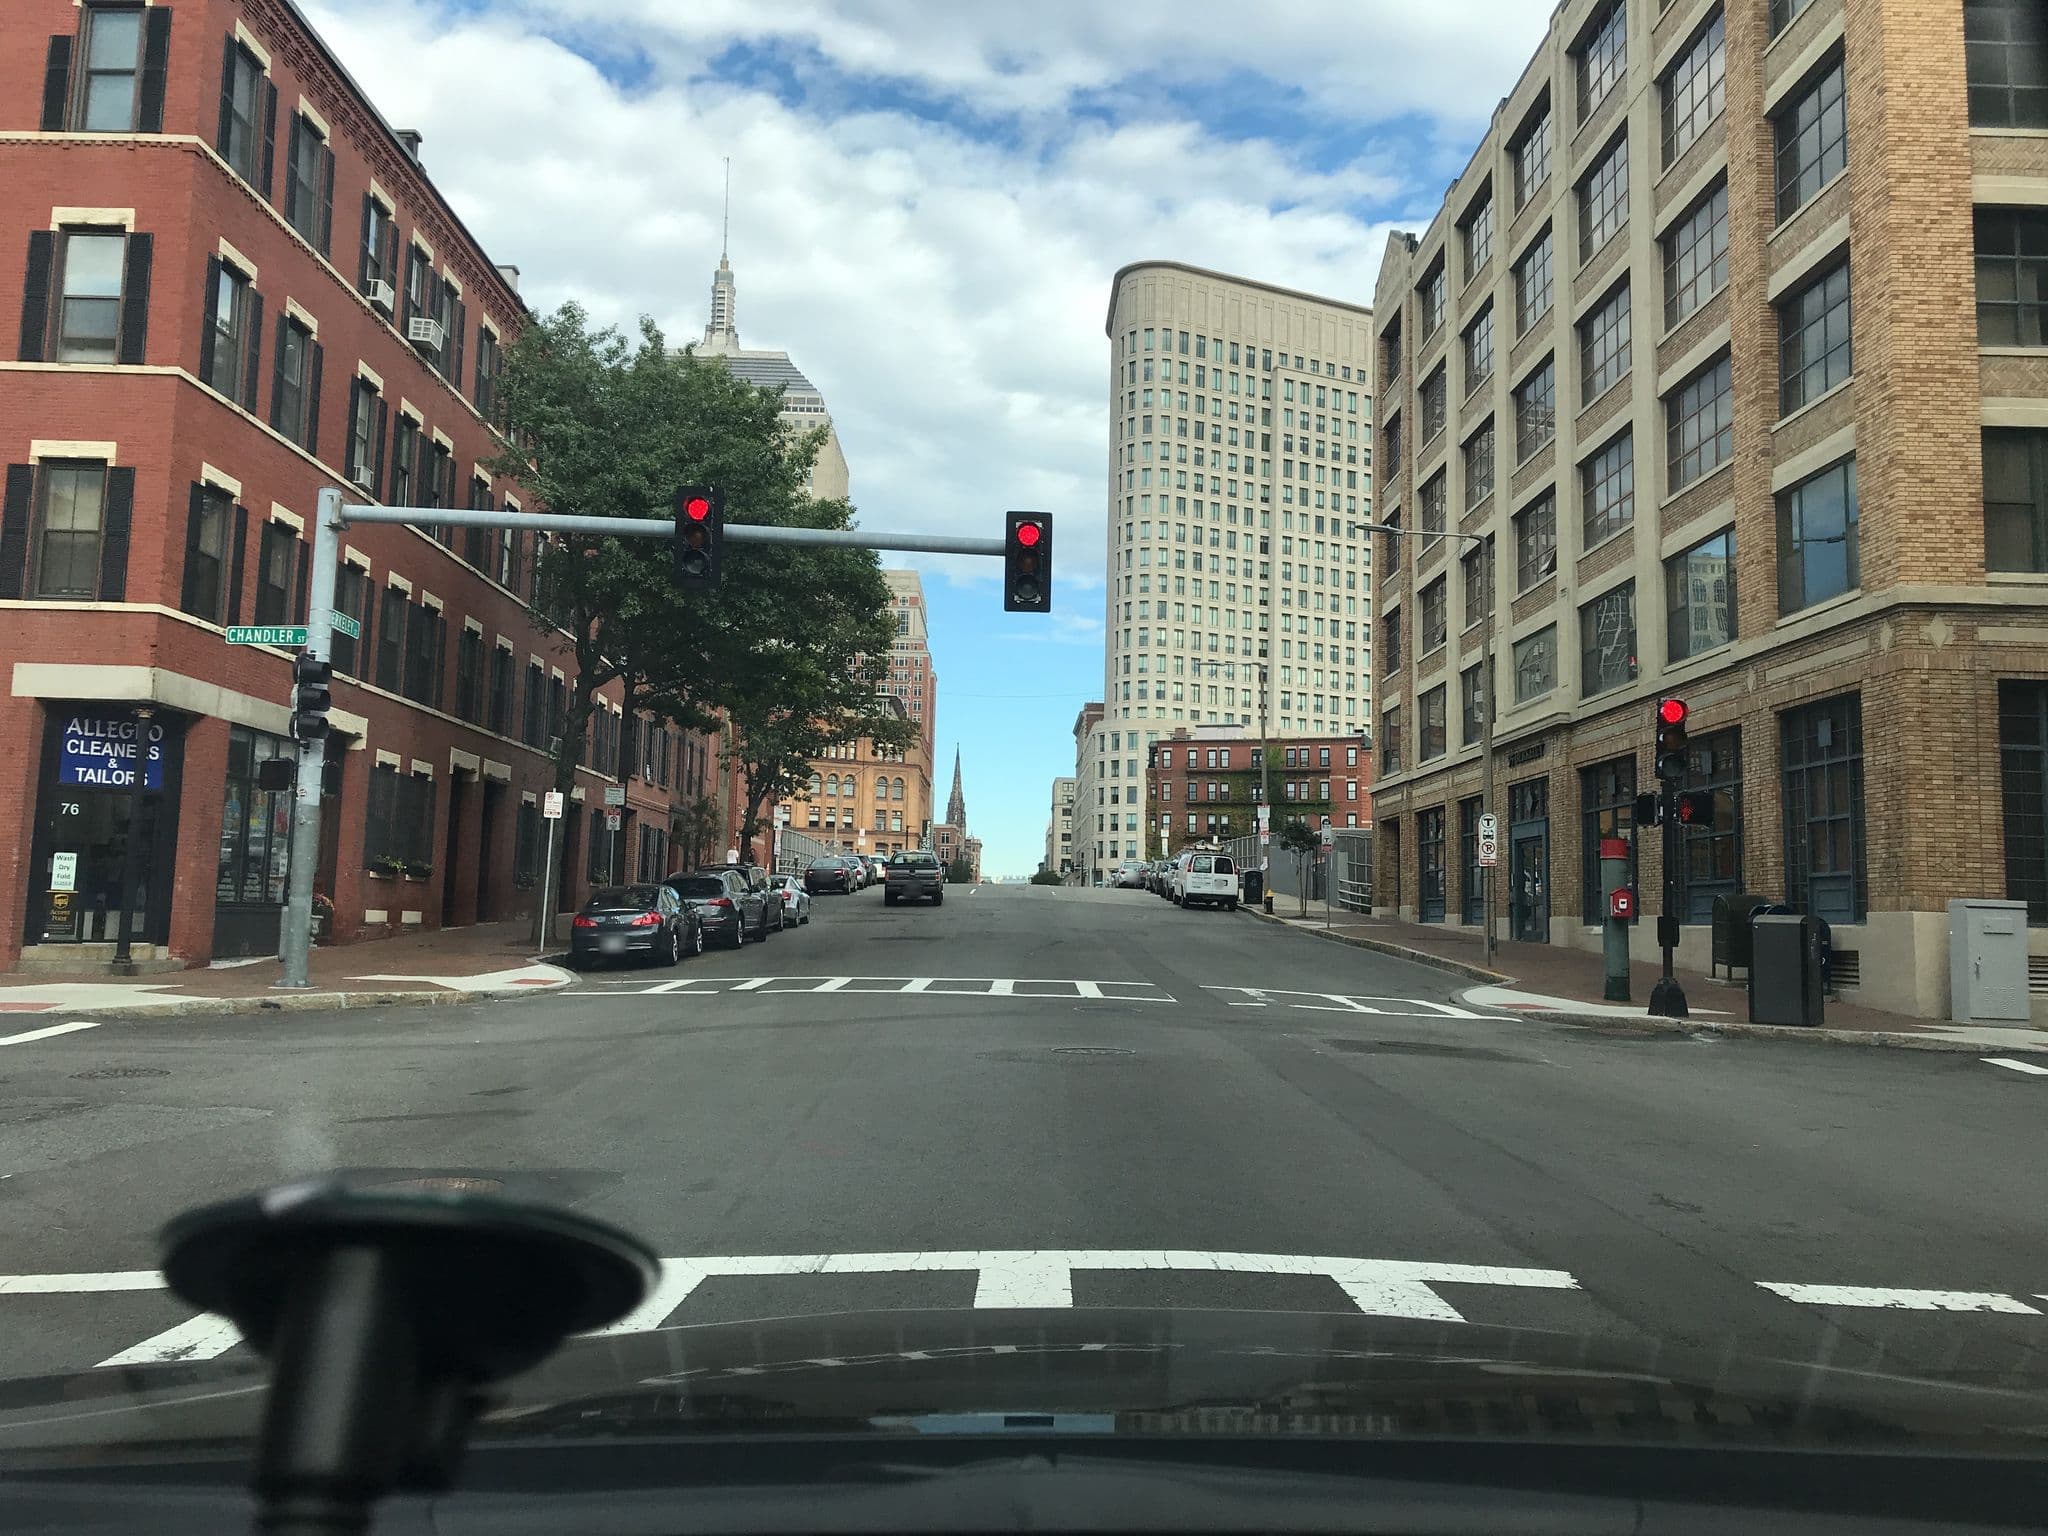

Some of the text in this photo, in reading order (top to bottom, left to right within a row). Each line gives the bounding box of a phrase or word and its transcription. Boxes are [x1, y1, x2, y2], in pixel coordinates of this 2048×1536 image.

[331, 611, 354, 634] ERKELEY
[228, 629, 305, 643] CHANDLER ST
[66, 717, 163, 742] ALLEGO
[66, 739, 160, 760] CLEANES
[107, 758, 118, 769] &
[60, 803, 80, 815] 76
